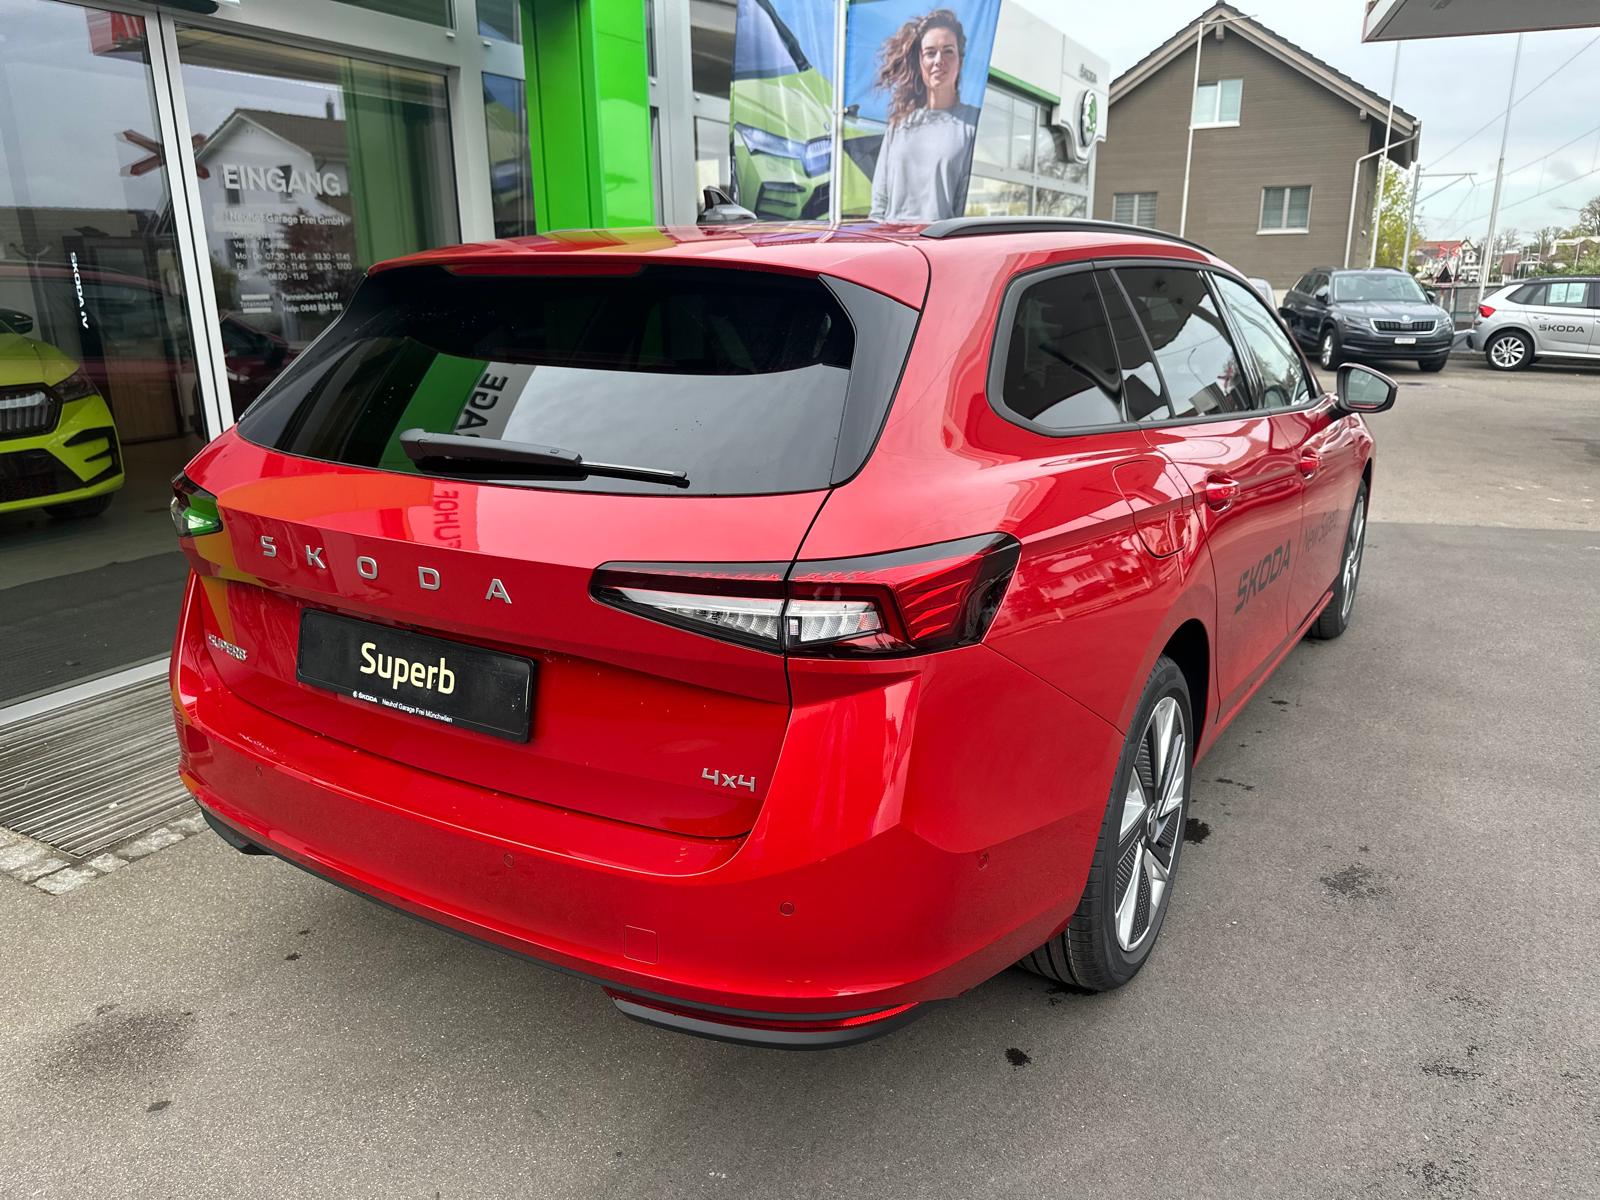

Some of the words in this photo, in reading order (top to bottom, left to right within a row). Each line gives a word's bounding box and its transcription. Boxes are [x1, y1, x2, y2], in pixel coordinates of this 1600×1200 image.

[223, 163, 341, 197] EINGANG
[266, 212, 298, 226] Garage
[300, 213, 318, 224] Frei
[319, 215, 345, 226] GmbH
[235, 252, 247, 260] Mo
[265, 252, 284, 260] 07.30
[290, 252, 306, 261] 11.45
[314, 252, 331, 261] 13.30
[266, 262, 286, 270] 07.30
[292, 262, 307, 270] 11.45
[337, 262, 352, 270] 17.00
[268, 273, 288, 281] 08.00
[293, 272, 309, 281] 11.45
[281, 292, 324, 301] Pannendienst
[324, 291, 339, 300] 24/7
[260, 535, 512, 604] SKODA
[208, 634, 247, 660] SUPERB
[360, 642, 455, 694] Superb
[382, 699, 399, 709] Neuhof
[399, 703, 416, 714] Garage
[416, 707, 425, 716] Frei
[702, 767, 756, 792] 4x4
